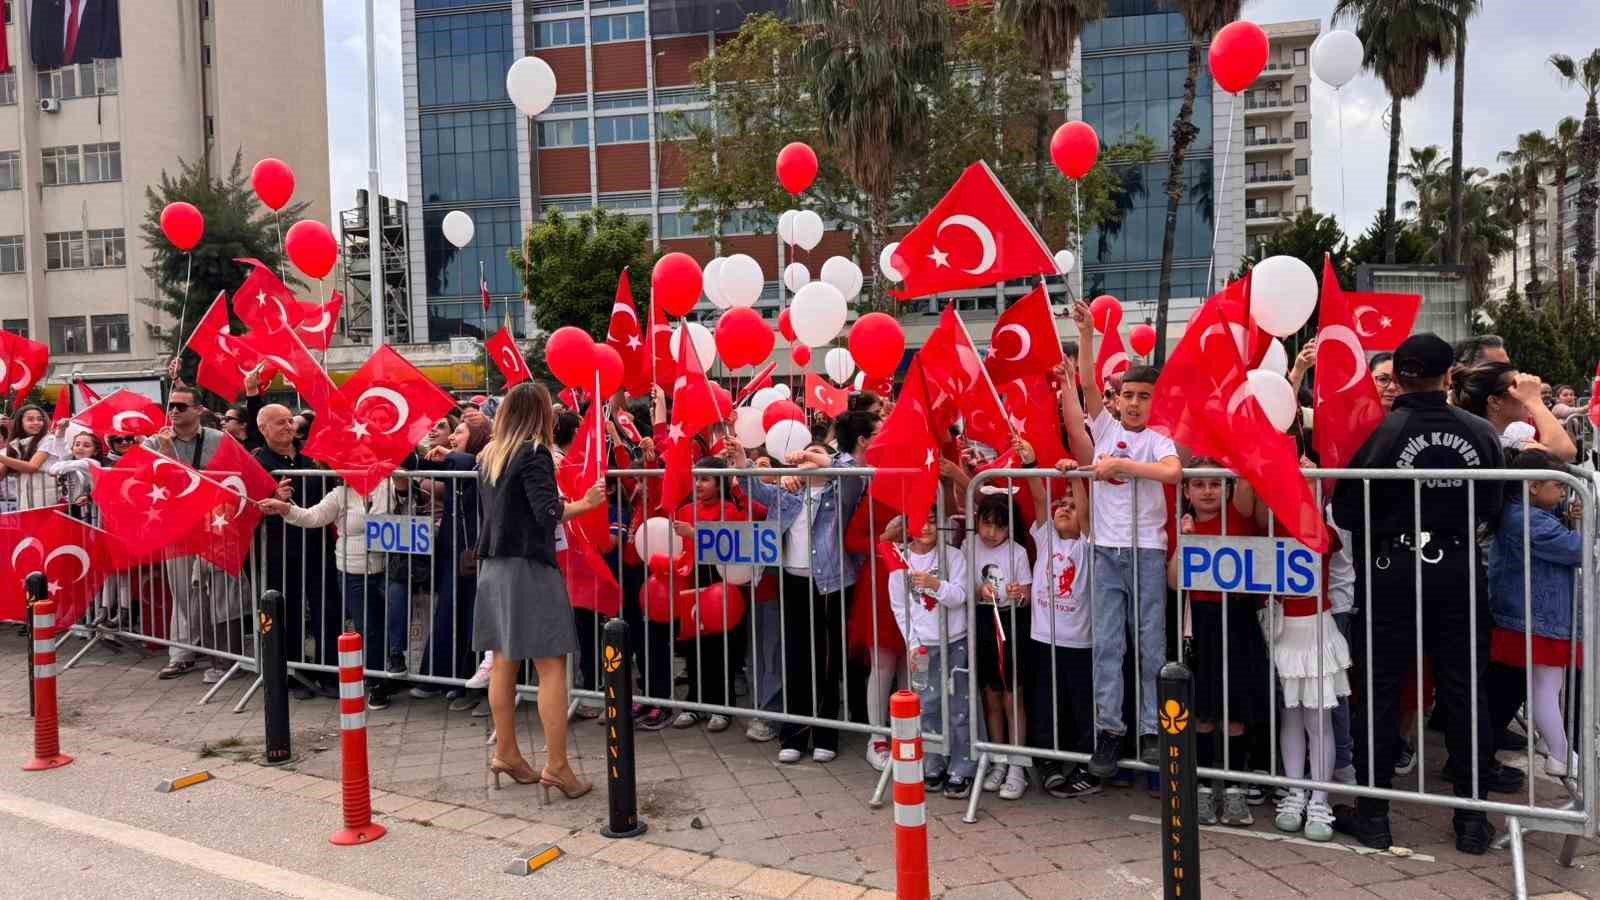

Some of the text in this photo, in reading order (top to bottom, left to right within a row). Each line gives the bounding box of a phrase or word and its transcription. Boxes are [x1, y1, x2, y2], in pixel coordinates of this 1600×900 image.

[1431, 432, 1480, 466] KUVVET
[367, 518, 430, 552] POLİS
[698, 523, 778, 563] POLİS
[1182, 541, 1315, 593] POLİS
[608, 686, 620, 779] ADANA
